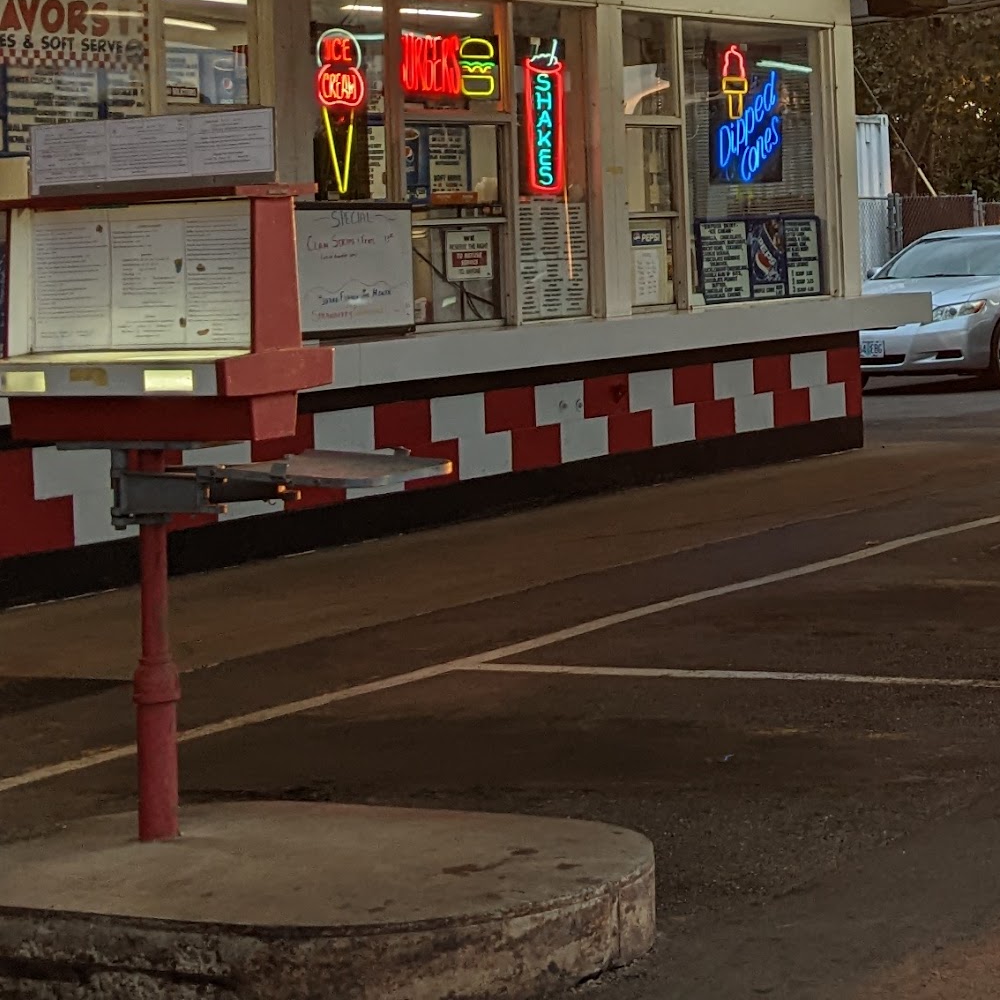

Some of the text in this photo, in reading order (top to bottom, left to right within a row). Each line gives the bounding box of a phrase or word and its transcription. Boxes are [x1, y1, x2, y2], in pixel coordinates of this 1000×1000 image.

[23, 34, 34, 49] &
[41, 35, 75, 50] SOFT
[81, 38, 123, 54] SERVE
[324, 38, 352, 61] ICE
[322, 73, 357, 100] CREAM
[536, 73, 554, 186] SHAKES
[719, 70, 776, 168] Dipped
[740, 115, 779, 182] Cones
[331, 211, 374, 228] SPECIAL
[641, 233, 661, 242] PEPSI
